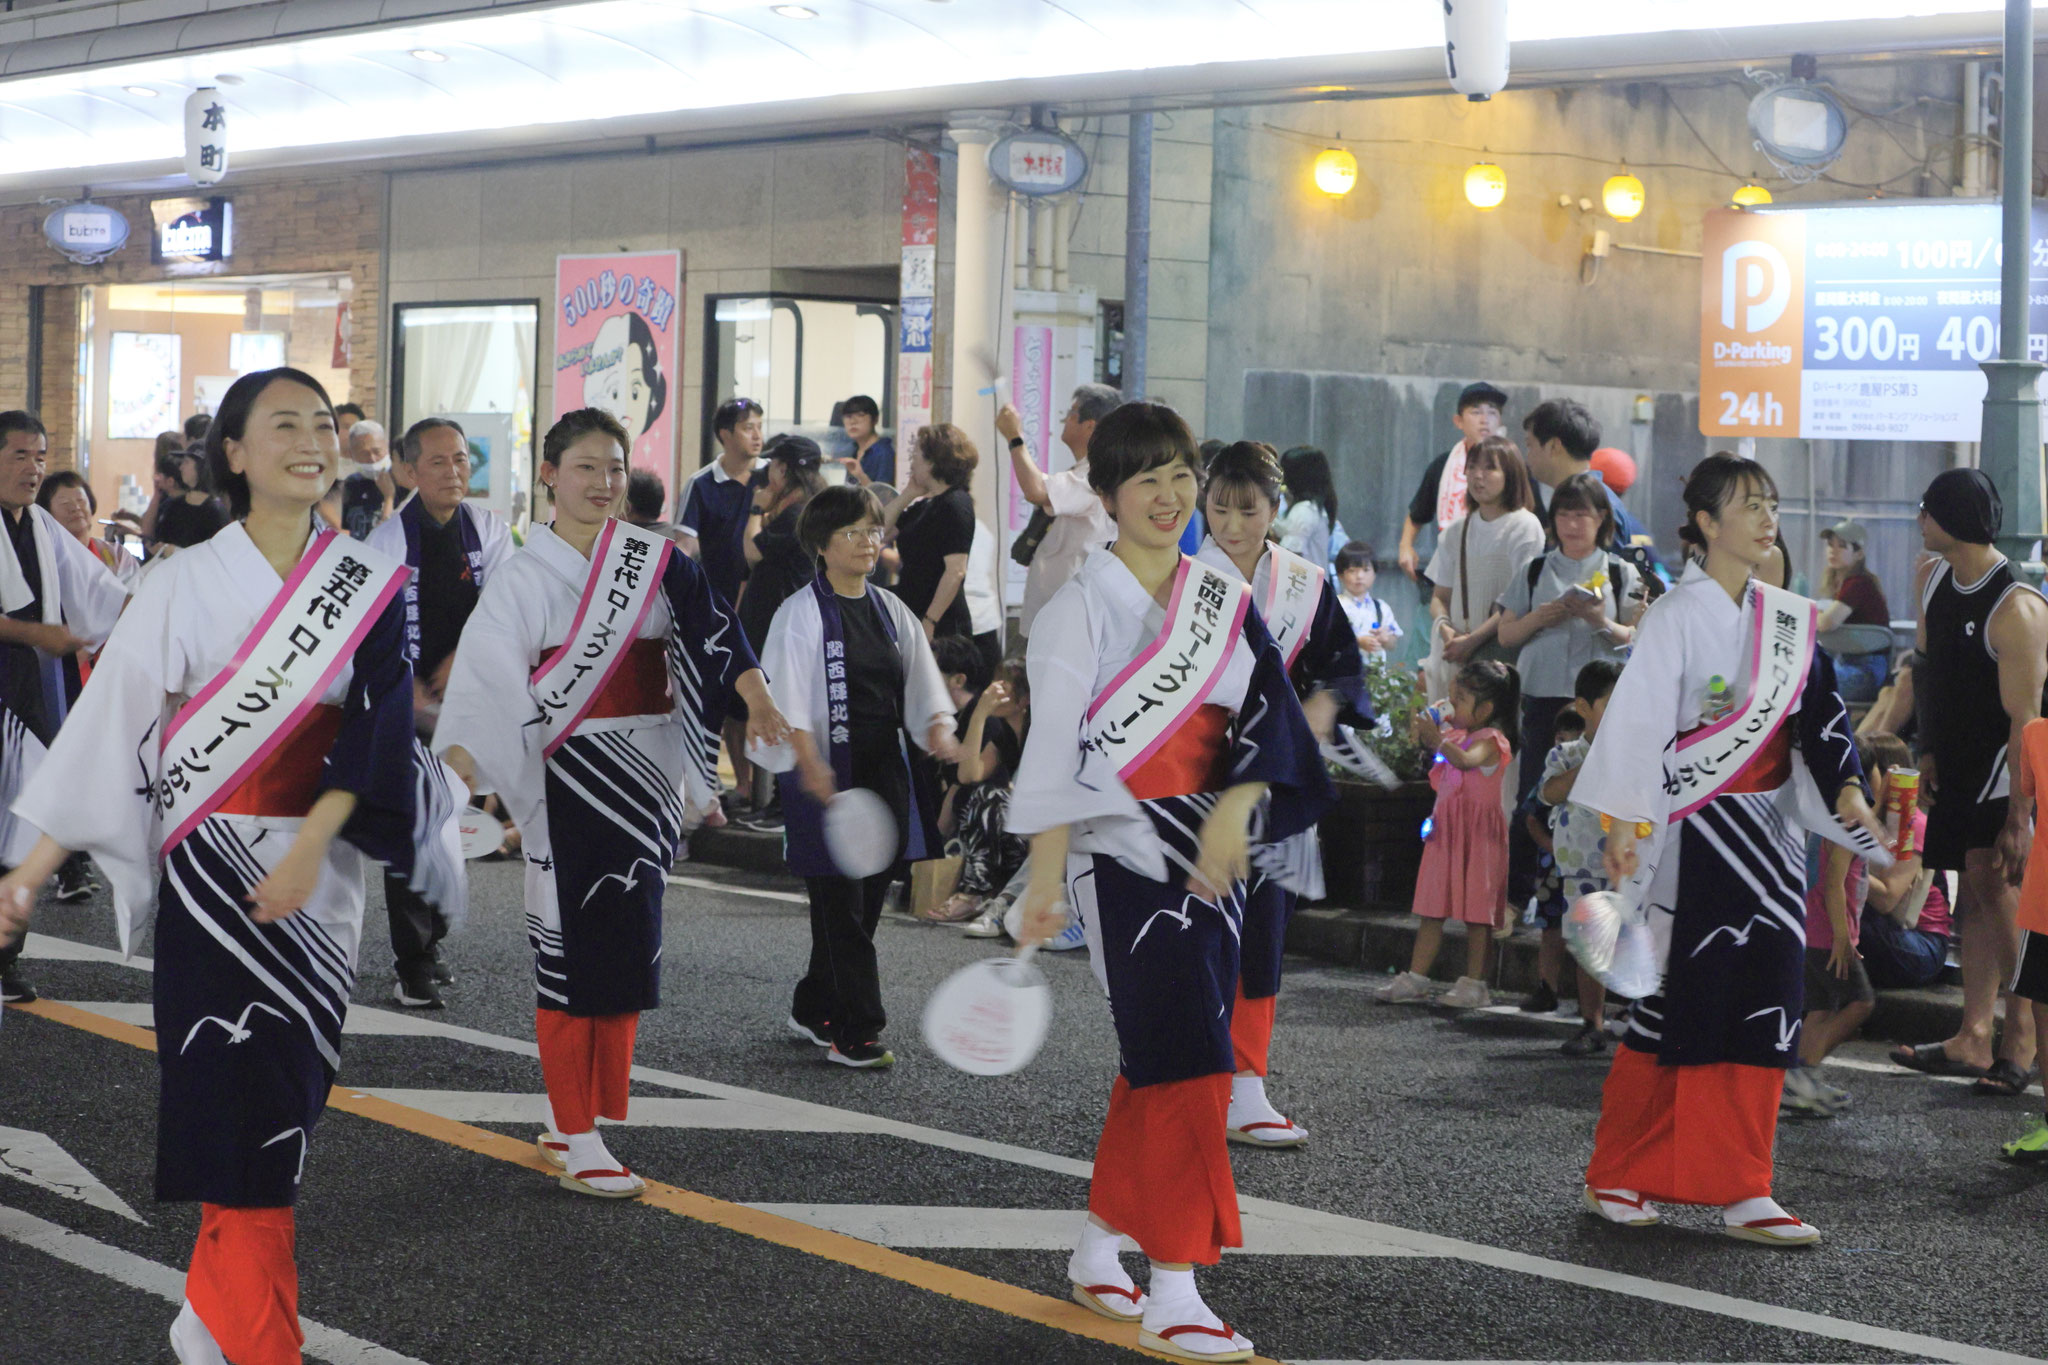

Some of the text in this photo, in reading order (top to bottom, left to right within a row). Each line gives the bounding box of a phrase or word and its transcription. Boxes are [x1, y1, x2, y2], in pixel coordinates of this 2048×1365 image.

[200, 102, 226, 172] 本町
[1714, 342, 1792, 364] D-Parking
[1814, 315, 2048, 362] 300円 40円
[1719, 391, 1783, 426] 24h
[826, 640, 849, 744] 関西輝北会
